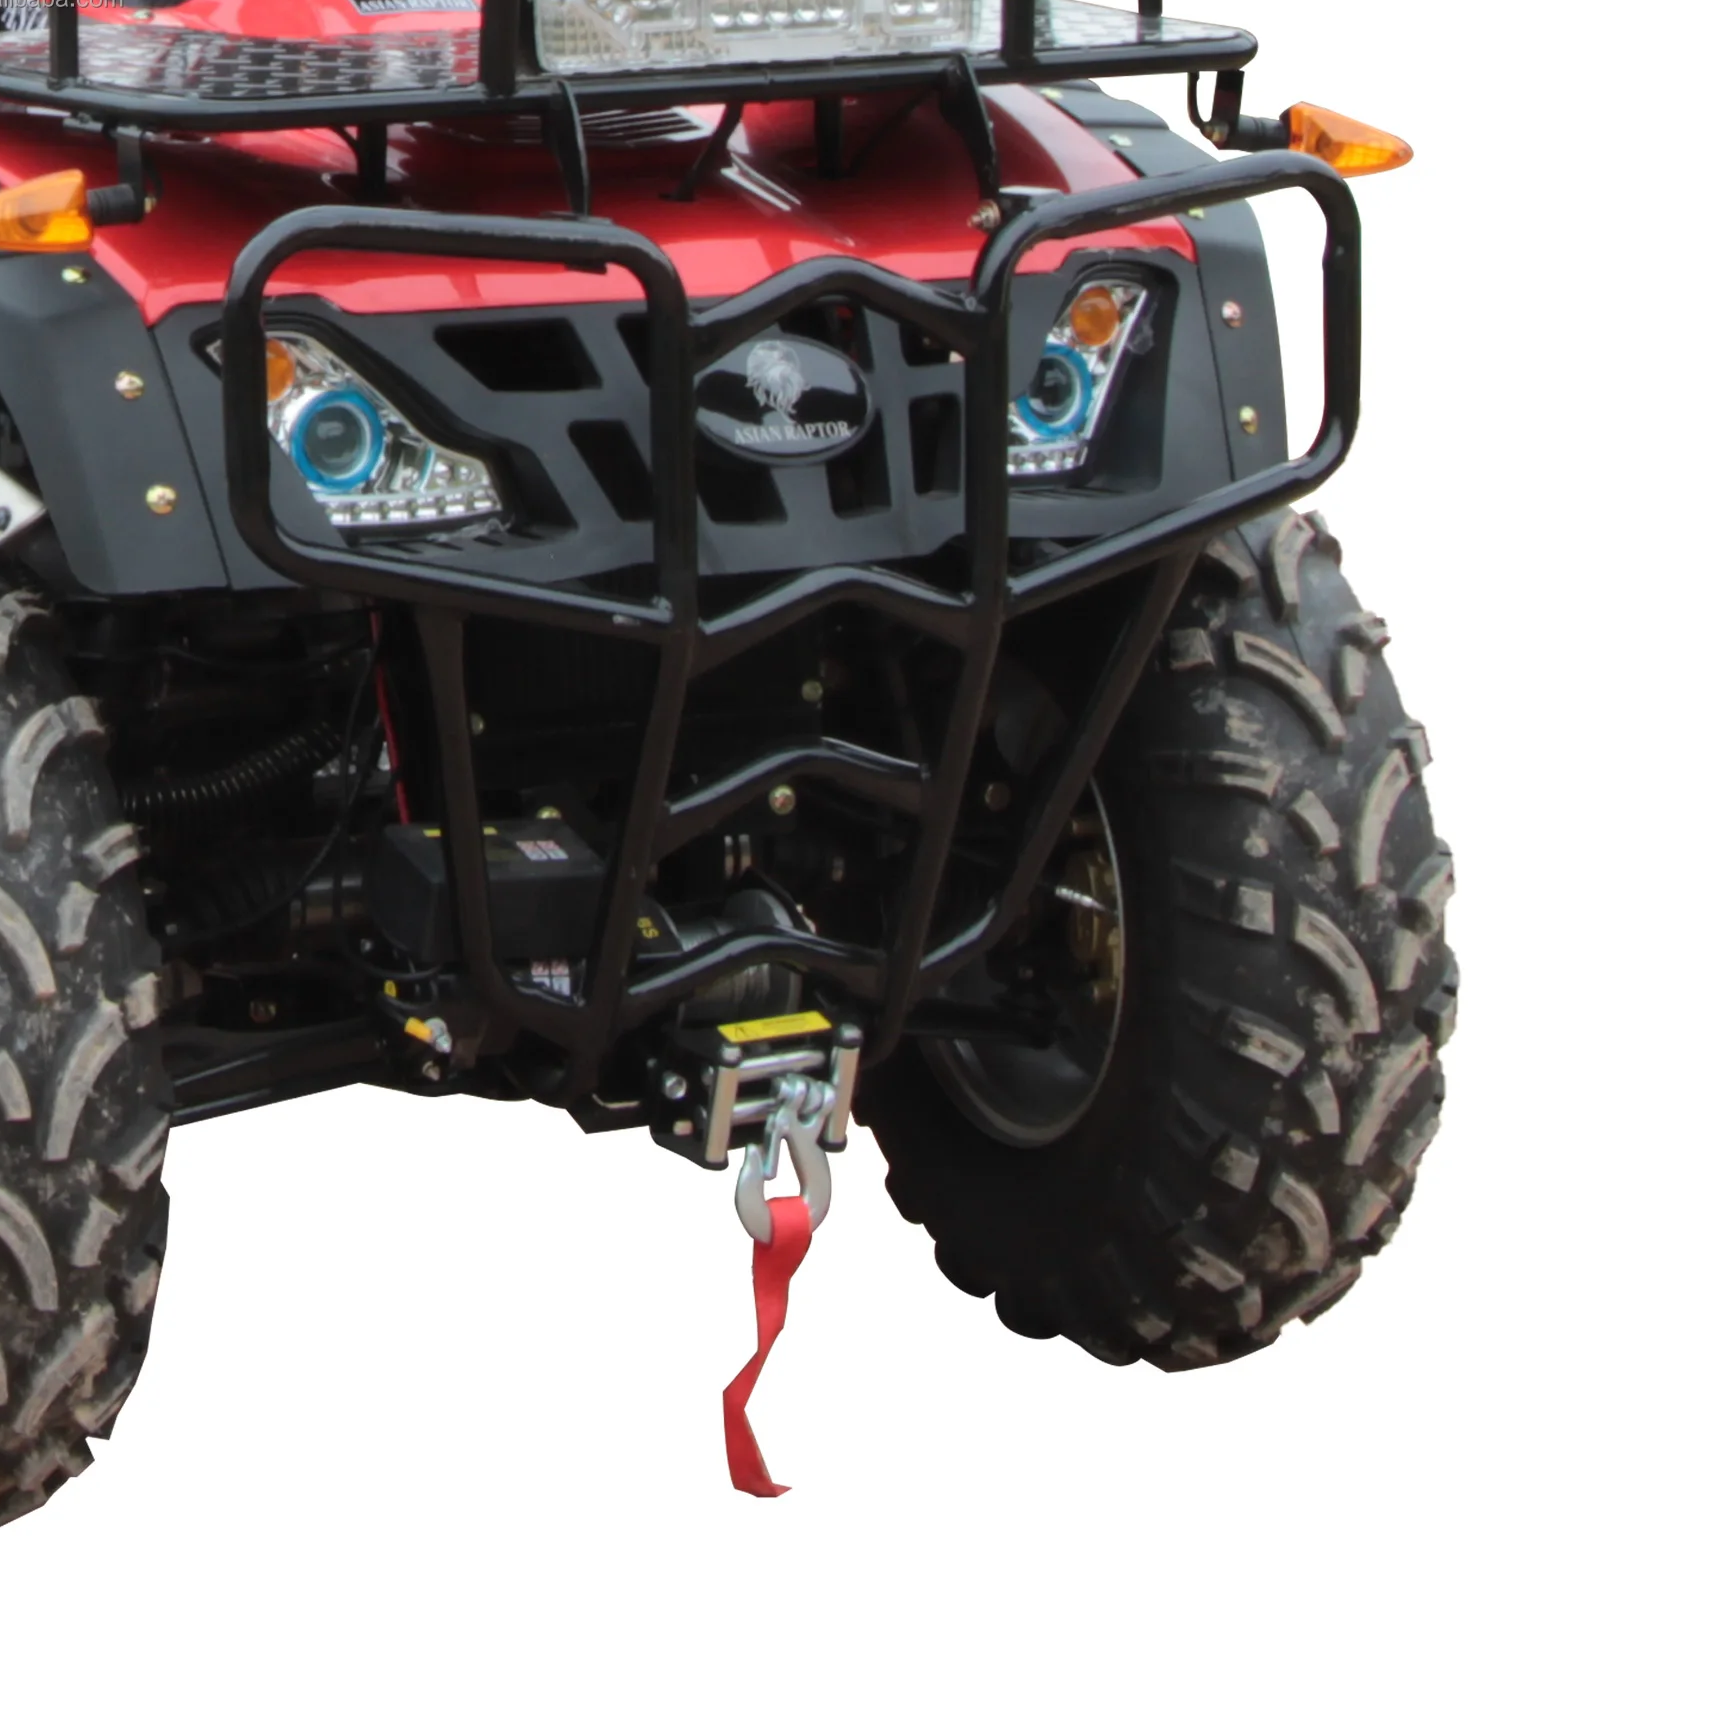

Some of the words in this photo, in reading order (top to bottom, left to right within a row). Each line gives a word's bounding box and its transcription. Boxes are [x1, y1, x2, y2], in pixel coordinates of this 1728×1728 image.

[360, 0, 406, 11] ASIAN
[735, 425, 783, 445] ASIAN
[783, 420, 852, 441] RAPTOR
